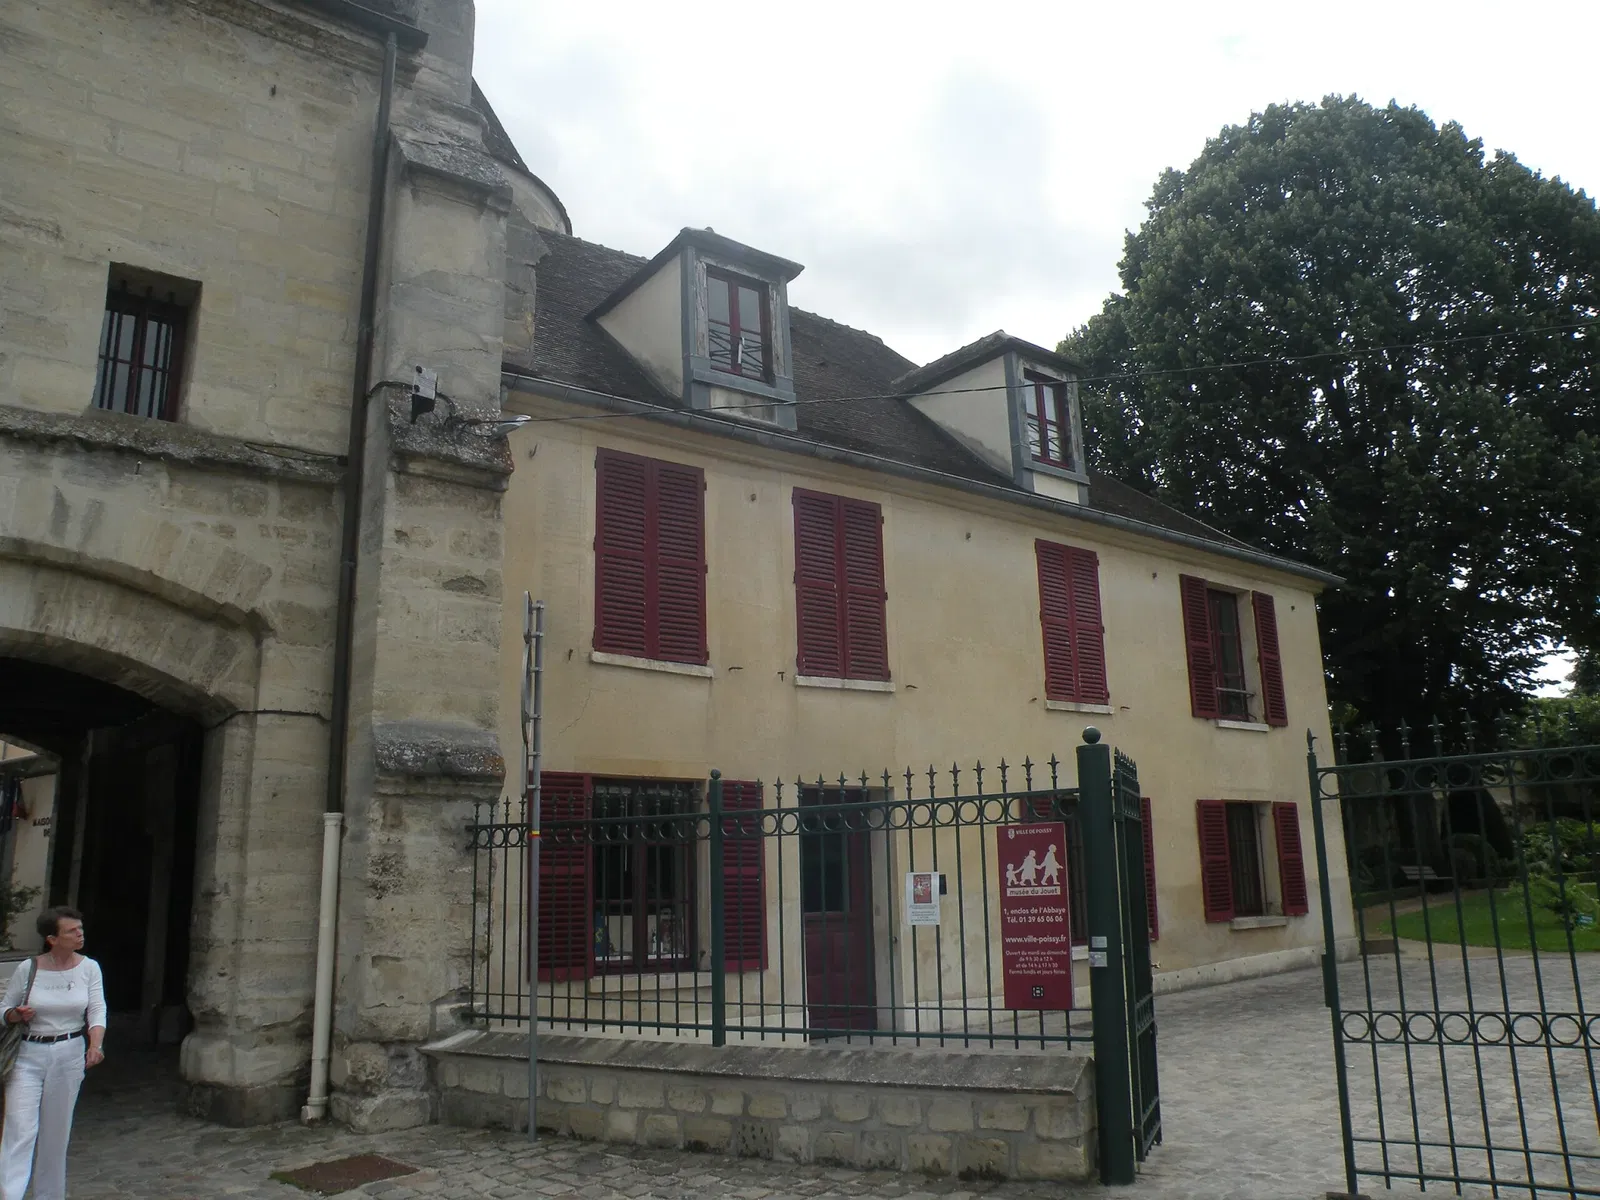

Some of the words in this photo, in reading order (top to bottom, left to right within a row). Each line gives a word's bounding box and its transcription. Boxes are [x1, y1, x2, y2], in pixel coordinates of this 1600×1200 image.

[1009, 888, 1029, 896] musée
[1040, 887, 1058, 895] Jouet
[1010, 907, 1029, 915] enclos
[1039, 906, 1066, 915] l'Abbaye
[1005, 934, 1066, 944] www.ville-poissy.fr
